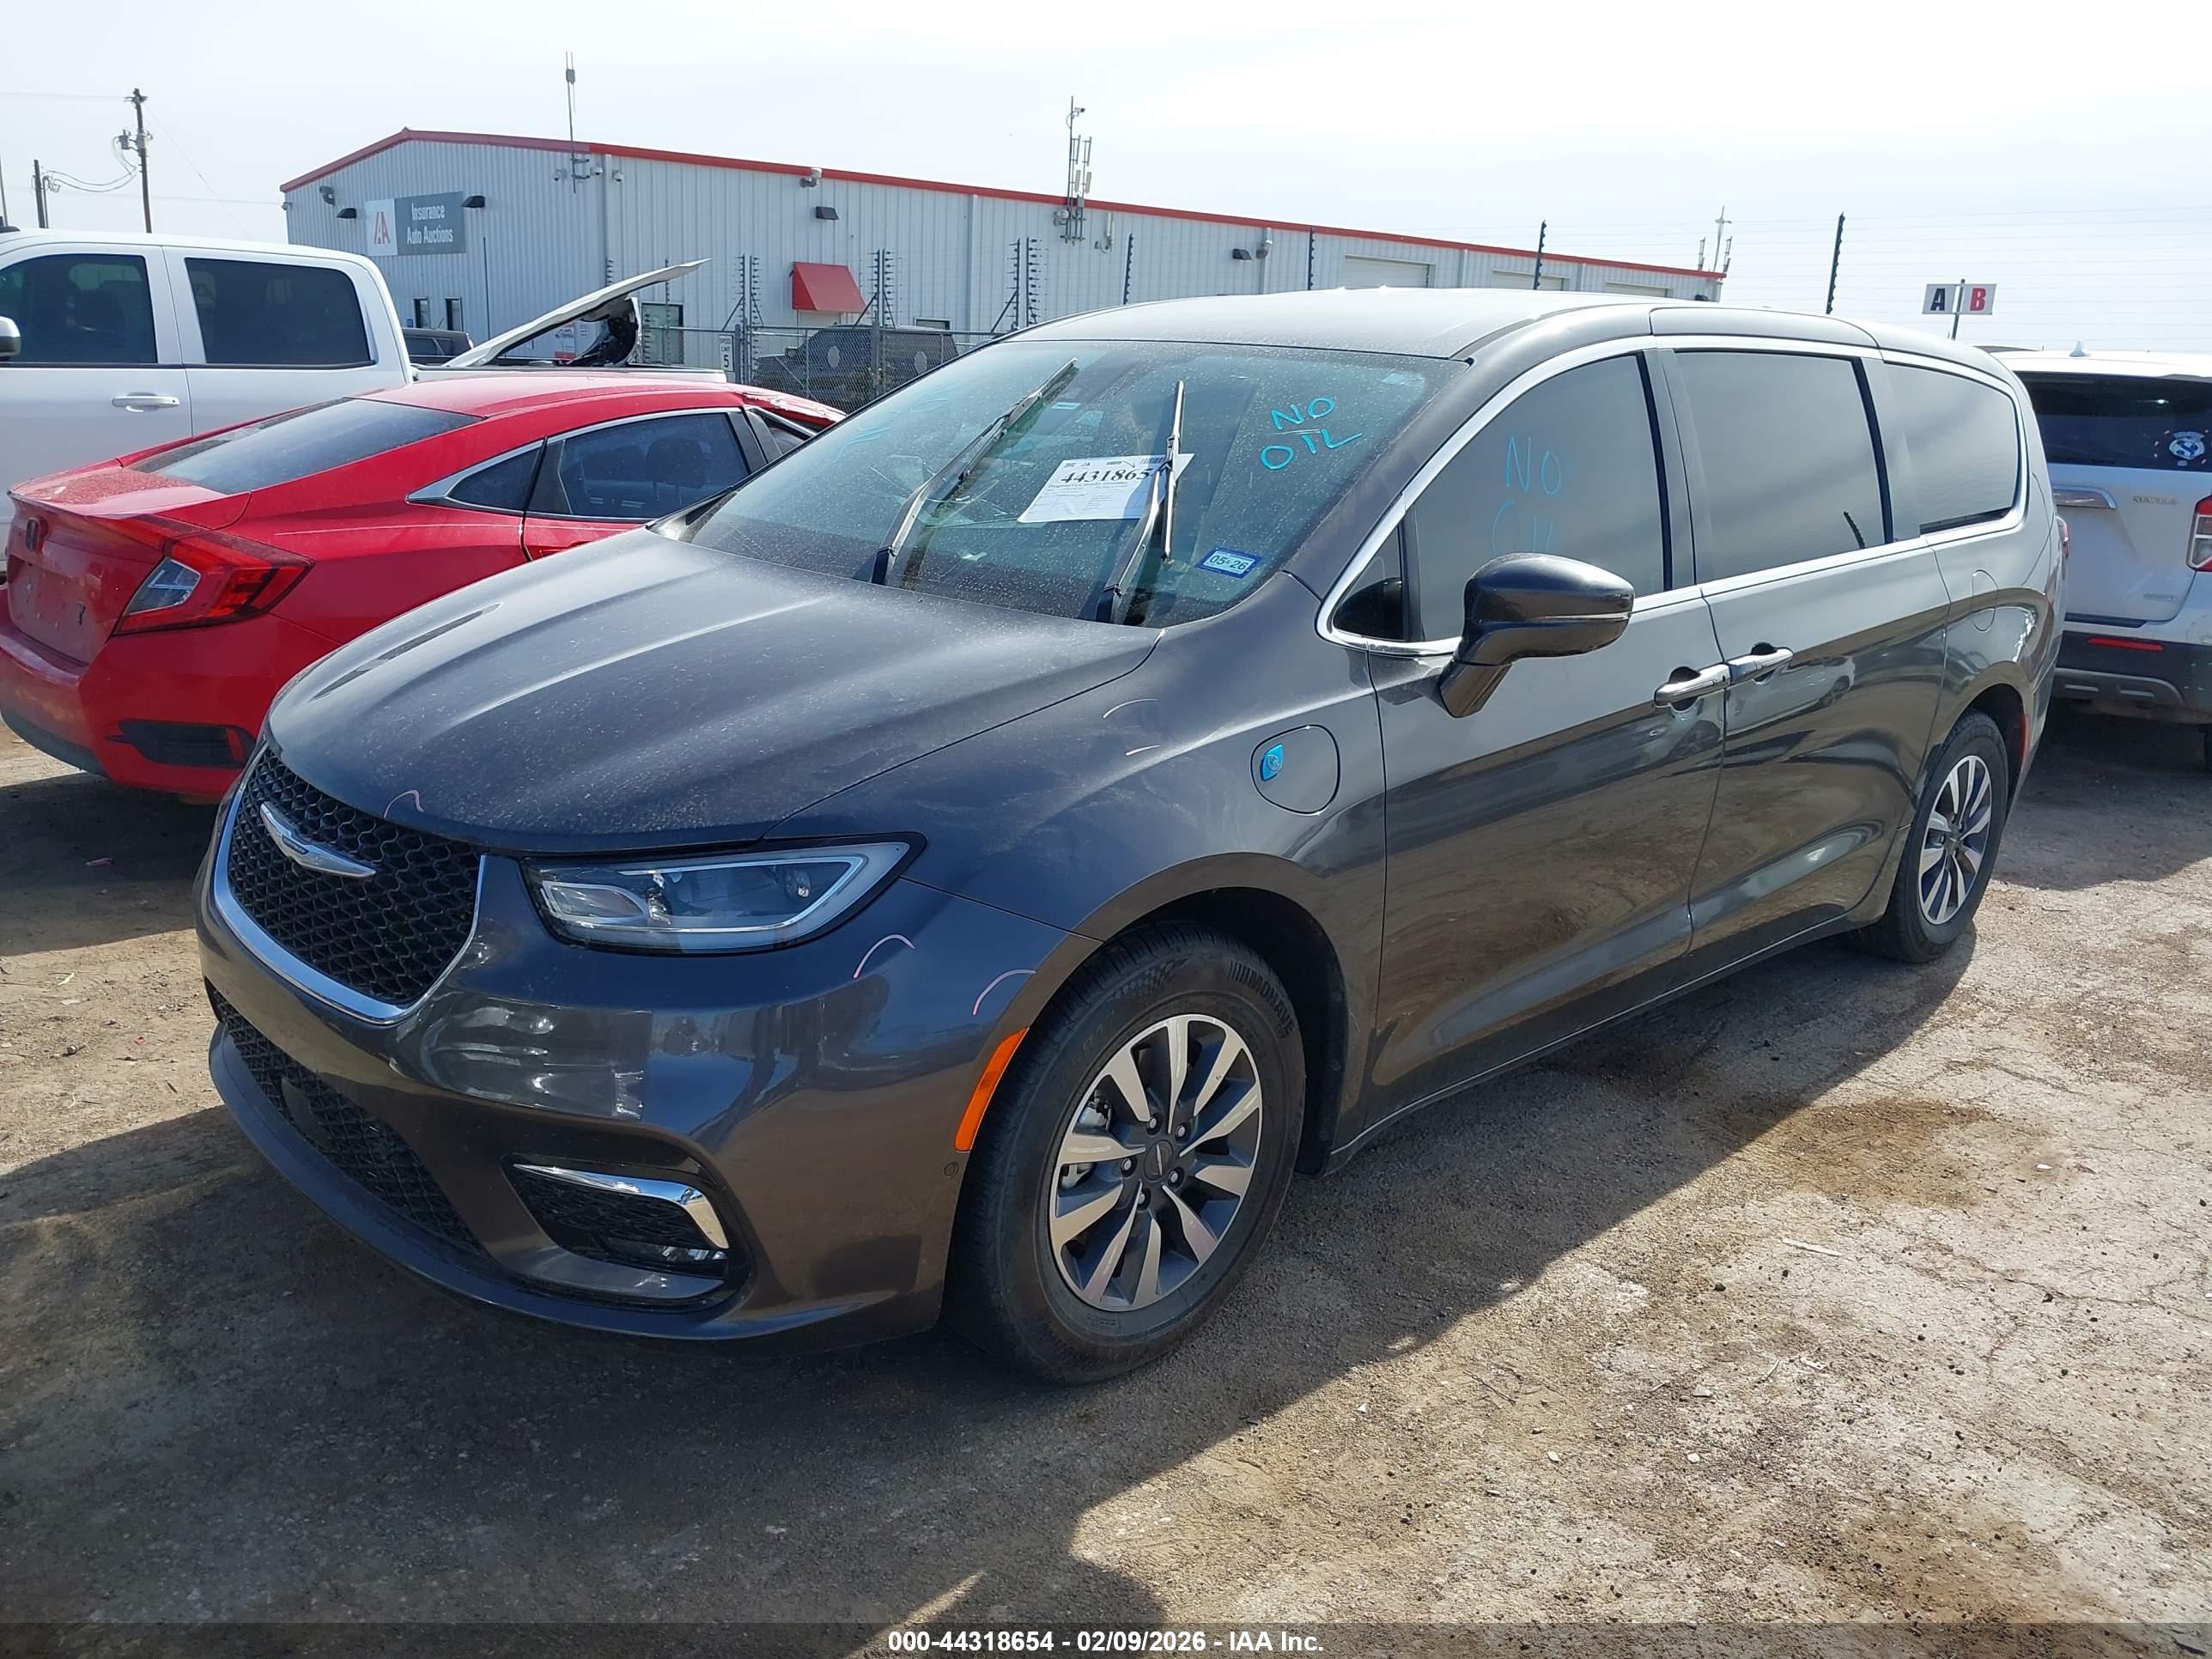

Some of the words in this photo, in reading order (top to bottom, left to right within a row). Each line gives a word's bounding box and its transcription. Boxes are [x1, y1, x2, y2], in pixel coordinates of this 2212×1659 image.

[411, 203, 445, 221] Insurance
[407, 227, 422, 244] Auto
[423, 224, 453, 243] Auctions
[1930, 288, 1946, 311] A
[1969, 288, 1986, 311] B
[724, 354, 730, 368] 5
[1271, 398, 1335, 430] NO
[1260, 428, 1363, 469] OIL
[1060, 468, 1159, 483] 4431865
[1505, 435, 1562, 495] NO
